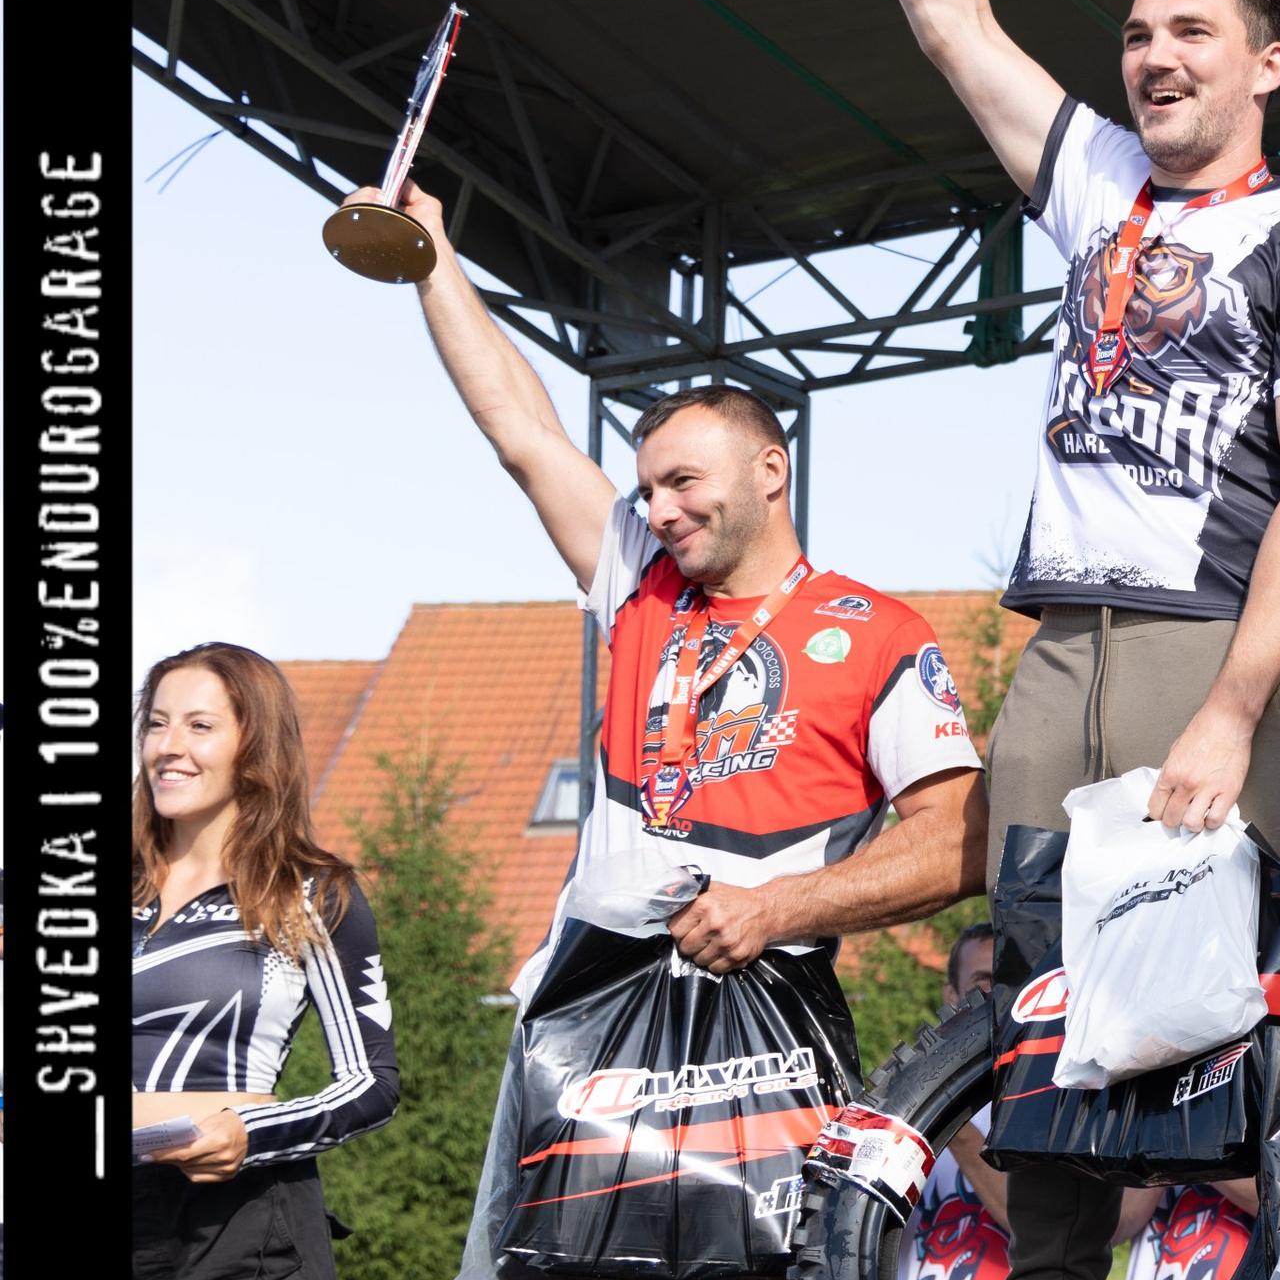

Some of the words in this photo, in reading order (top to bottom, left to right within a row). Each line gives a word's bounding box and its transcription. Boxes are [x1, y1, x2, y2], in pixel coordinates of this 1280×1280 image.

[1095, 372, 1106, 397] 1
[1123, 464, 1184, 489] DURO
[712, 646, 739, 674] HARD
[689, 674, 717, 715] ENDURO
[688, 748, 778, 783] ACING
[650, 802, 671, 827] 3
[1199, 1063, 1233, 1092] USA
[655, 1085, 750, 1113] RACING
[752, 1073, 820, 1096] OILS
